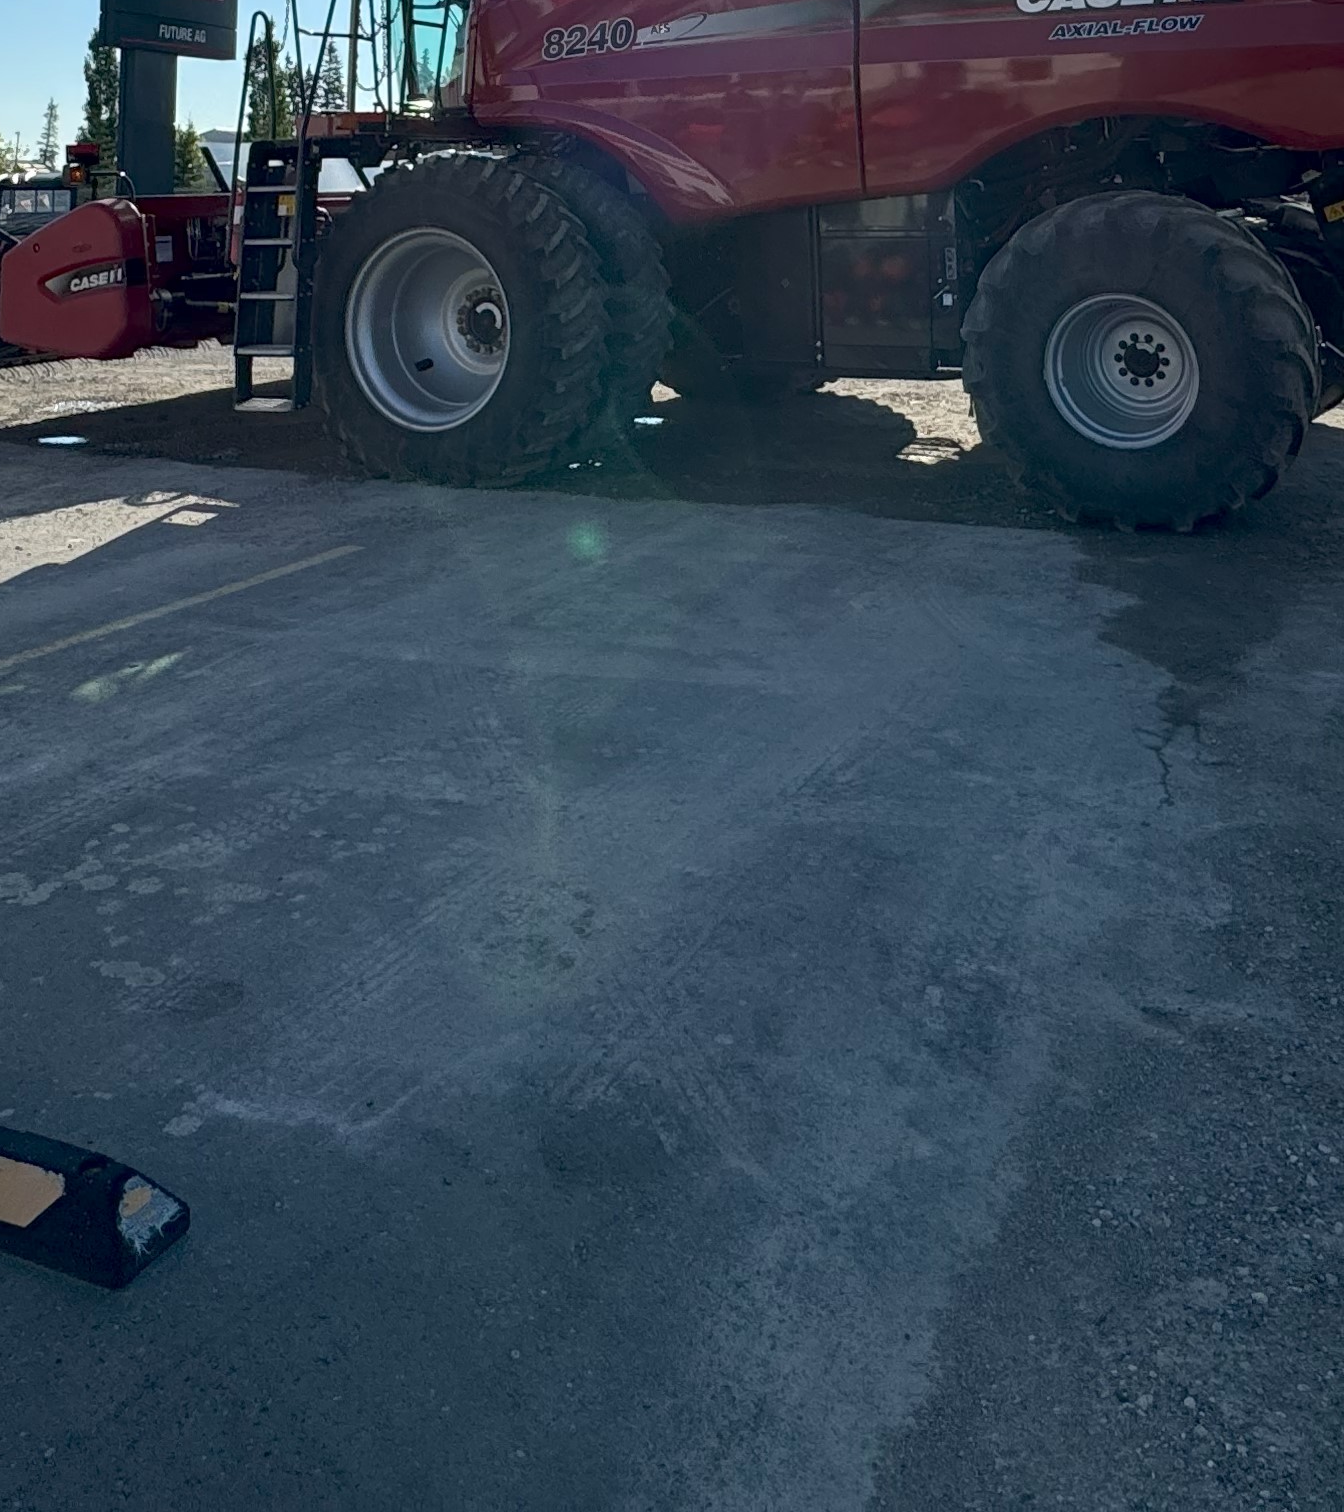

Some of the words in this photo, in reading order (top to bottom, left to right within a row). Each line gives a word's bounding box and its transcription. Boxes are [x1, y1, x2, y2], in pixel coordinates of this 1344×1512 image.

[159, 24, 193, 41] FUTURE
[194, 28, 206, 43] AG
[542, 17, 634, 61] 8240
[650, 24, 671, 36] AFS
[1048, 15, 1205, 40] AXIAL-FLOW
